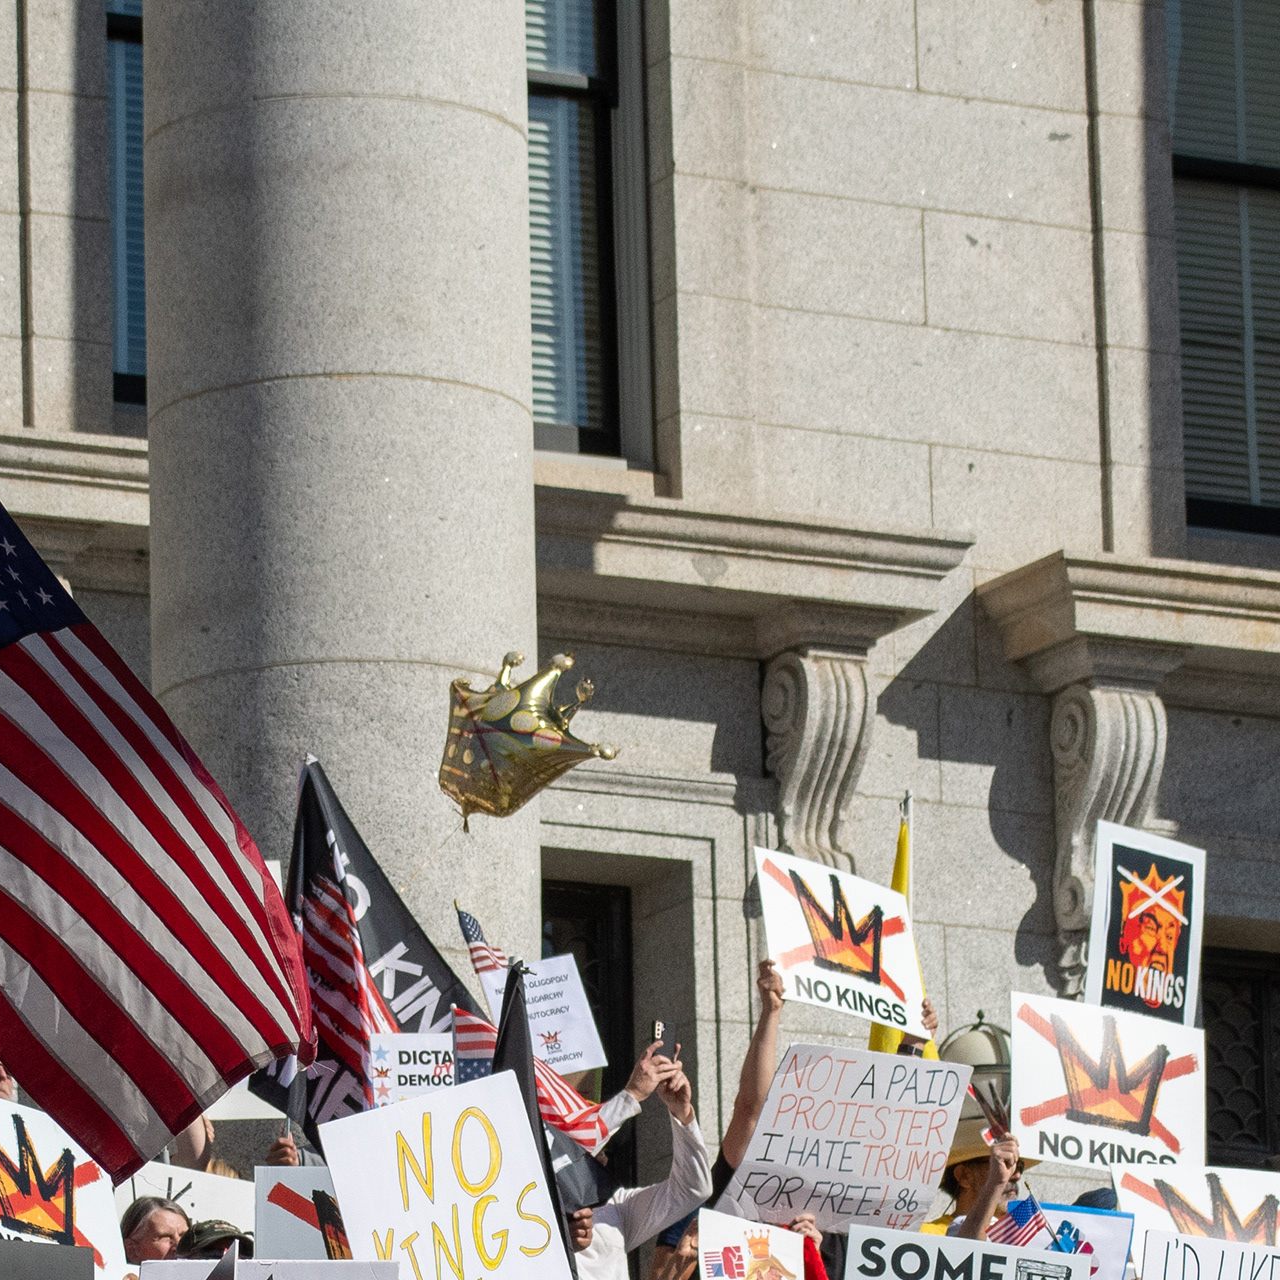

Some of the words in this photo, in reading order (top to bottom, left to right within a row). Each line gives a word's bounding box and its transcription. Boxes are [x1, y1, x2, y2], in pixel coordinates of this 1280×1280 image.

[794, 974, 832, 1004] NO
[836, 988, 909, 1028] KINGS
[1105, 957, 1135, 996] NO
[1132, 967, 1185, 1010] KINGS
[780, 1053, 857, 1095] NOT
[851, 1064, 876, 1099] A
[885, 1064, 959, 1107] PAID
[772, 1093, 948, 1148] PROTESTER
[1038, 1130, 1084, 1163] NO
[395, 1106, 502, 1212] NO
[756, 1132, 784, 1162] I
[785, 1136, 861, 1172] HATE
[861, 1144, 948, 1185] TRUMP
[737, 1171, 804, 1209] FOR
[894, 1188, 919, 1213] 86
[886, 1213, 913, 1229] 47
